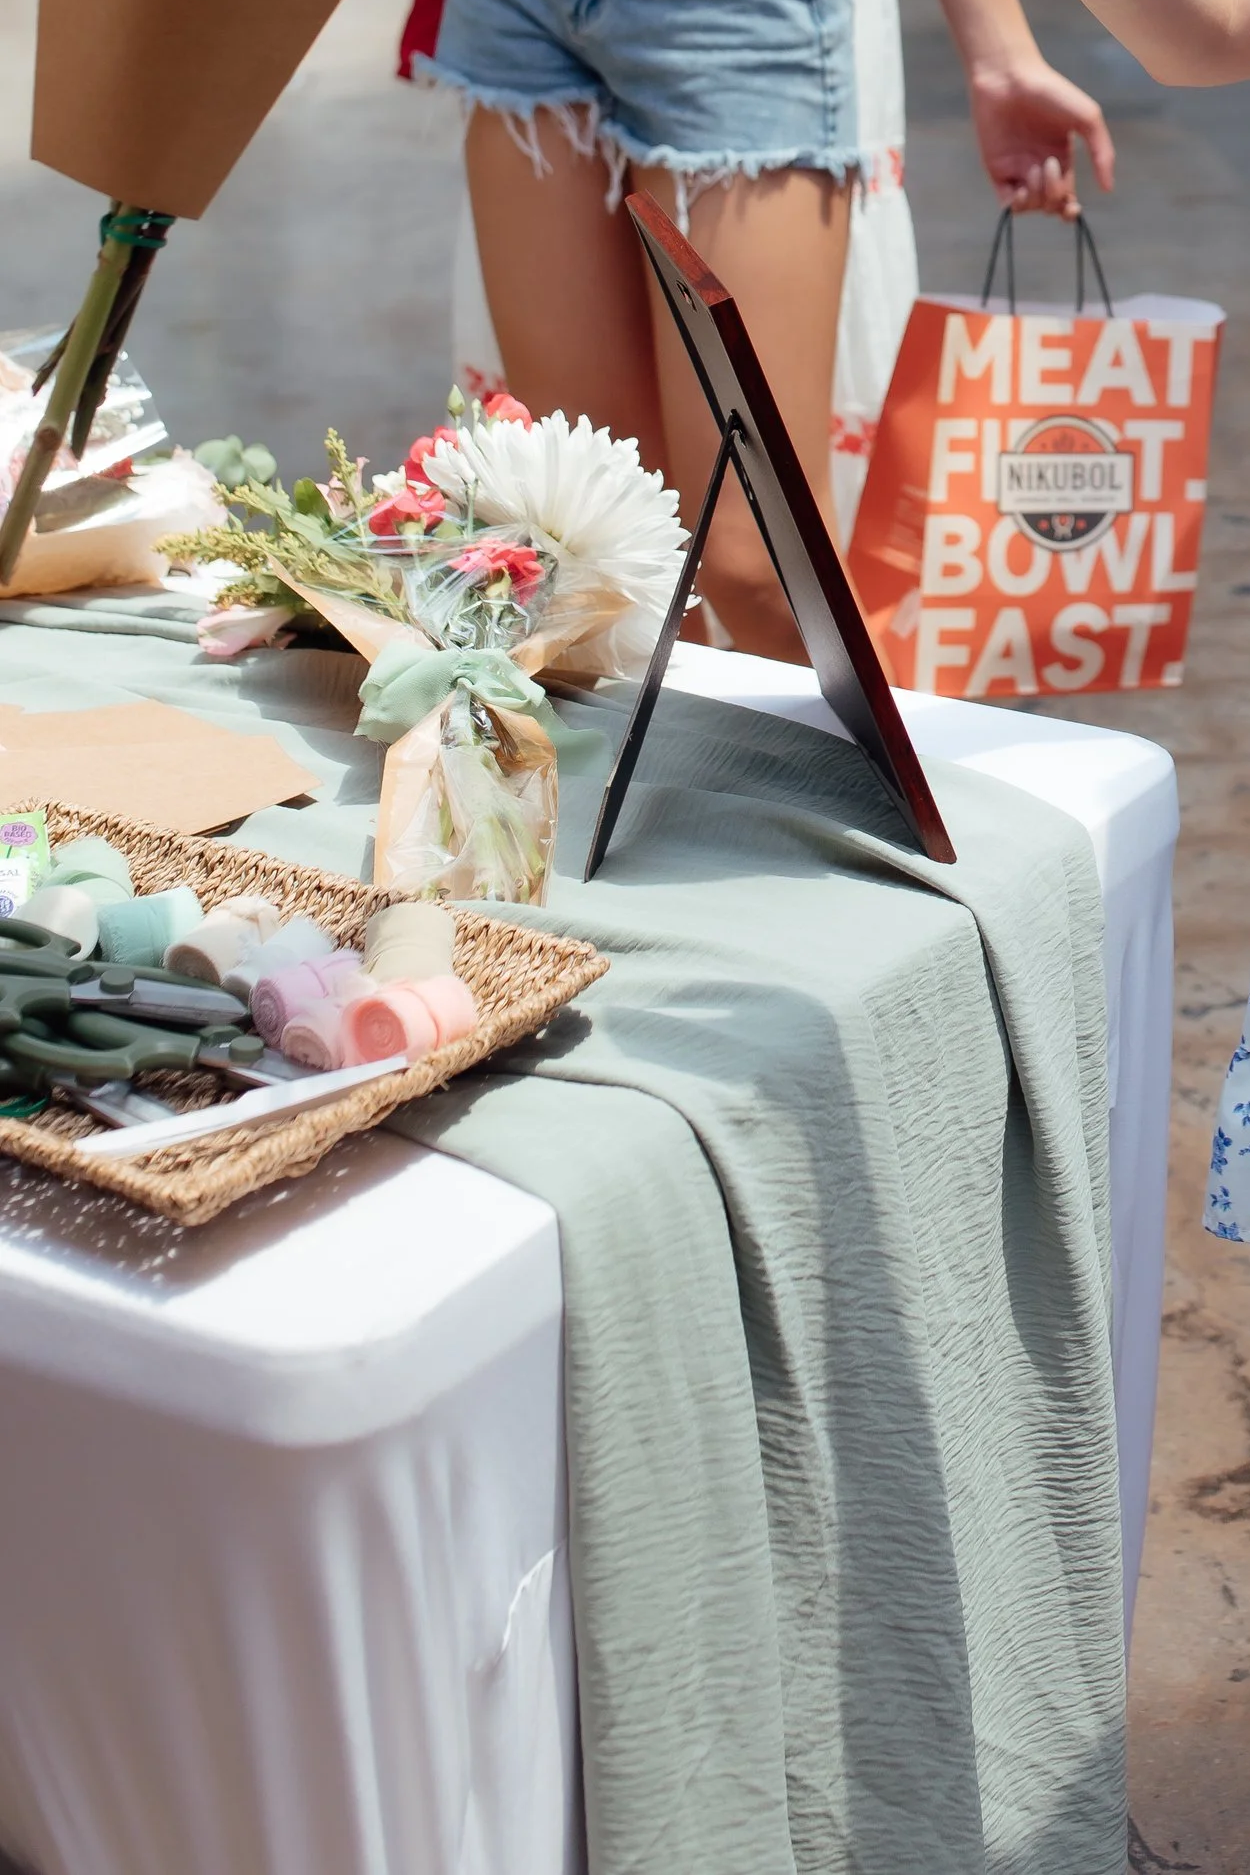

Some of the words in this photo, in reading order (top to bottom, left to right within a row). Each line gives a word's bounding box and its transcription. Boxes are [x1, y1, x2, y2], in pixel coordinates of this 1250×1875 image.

[937, 313, 1217, 407] MEAT
[928, 418, 1207, 502] FIT.
[1007, 462, 1122, 491] NIKUBOL
[922, 512, 1197, 596] BOWL
[914, 603, 1184, 697] FAST.
